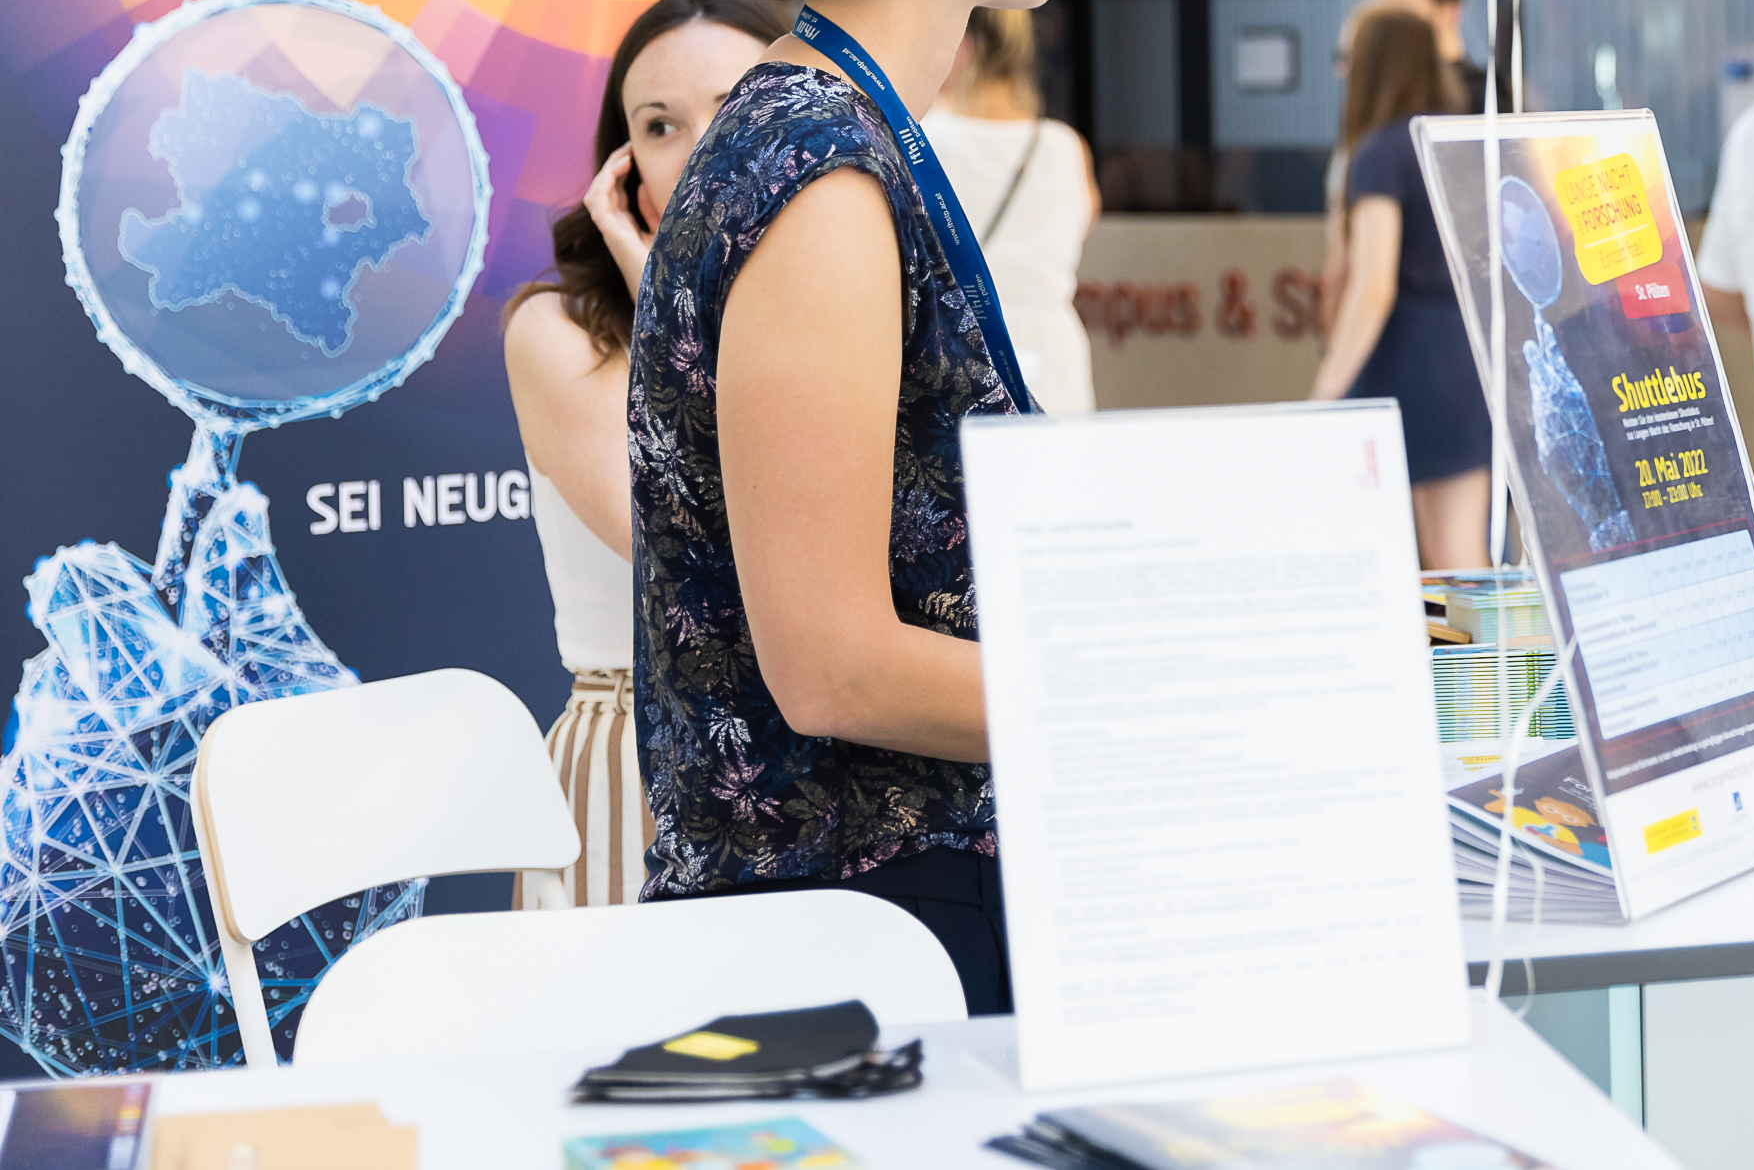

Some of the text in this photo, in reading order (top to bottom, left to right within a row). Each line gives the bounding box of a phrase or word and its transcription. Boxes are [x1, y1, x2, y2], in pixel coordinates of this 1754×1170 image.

[841, 47, 886, 92] www.fhstp.ac.at
[1563, 164, 1633, 205] LANGE NACHT
[934, 192, 960, 246] www.fhstp.ac.at
[1581, 194, 1642, 233] FORSCHUNG
[1215, 267, 1257, 340] &
[1634, 282, 1671, 301] St. Pölten
[1611, 366, 1707, 413] Shuttlebus
[1634, 448, 1709, 487] 20. Mai 2022
[306, 469, 534, 536] SEI NEUG
[1641, 488, 1664, 509] 17:00
[1666, 483, 1690, 504] 23:00
[1563, 776, 1592, 793] For
